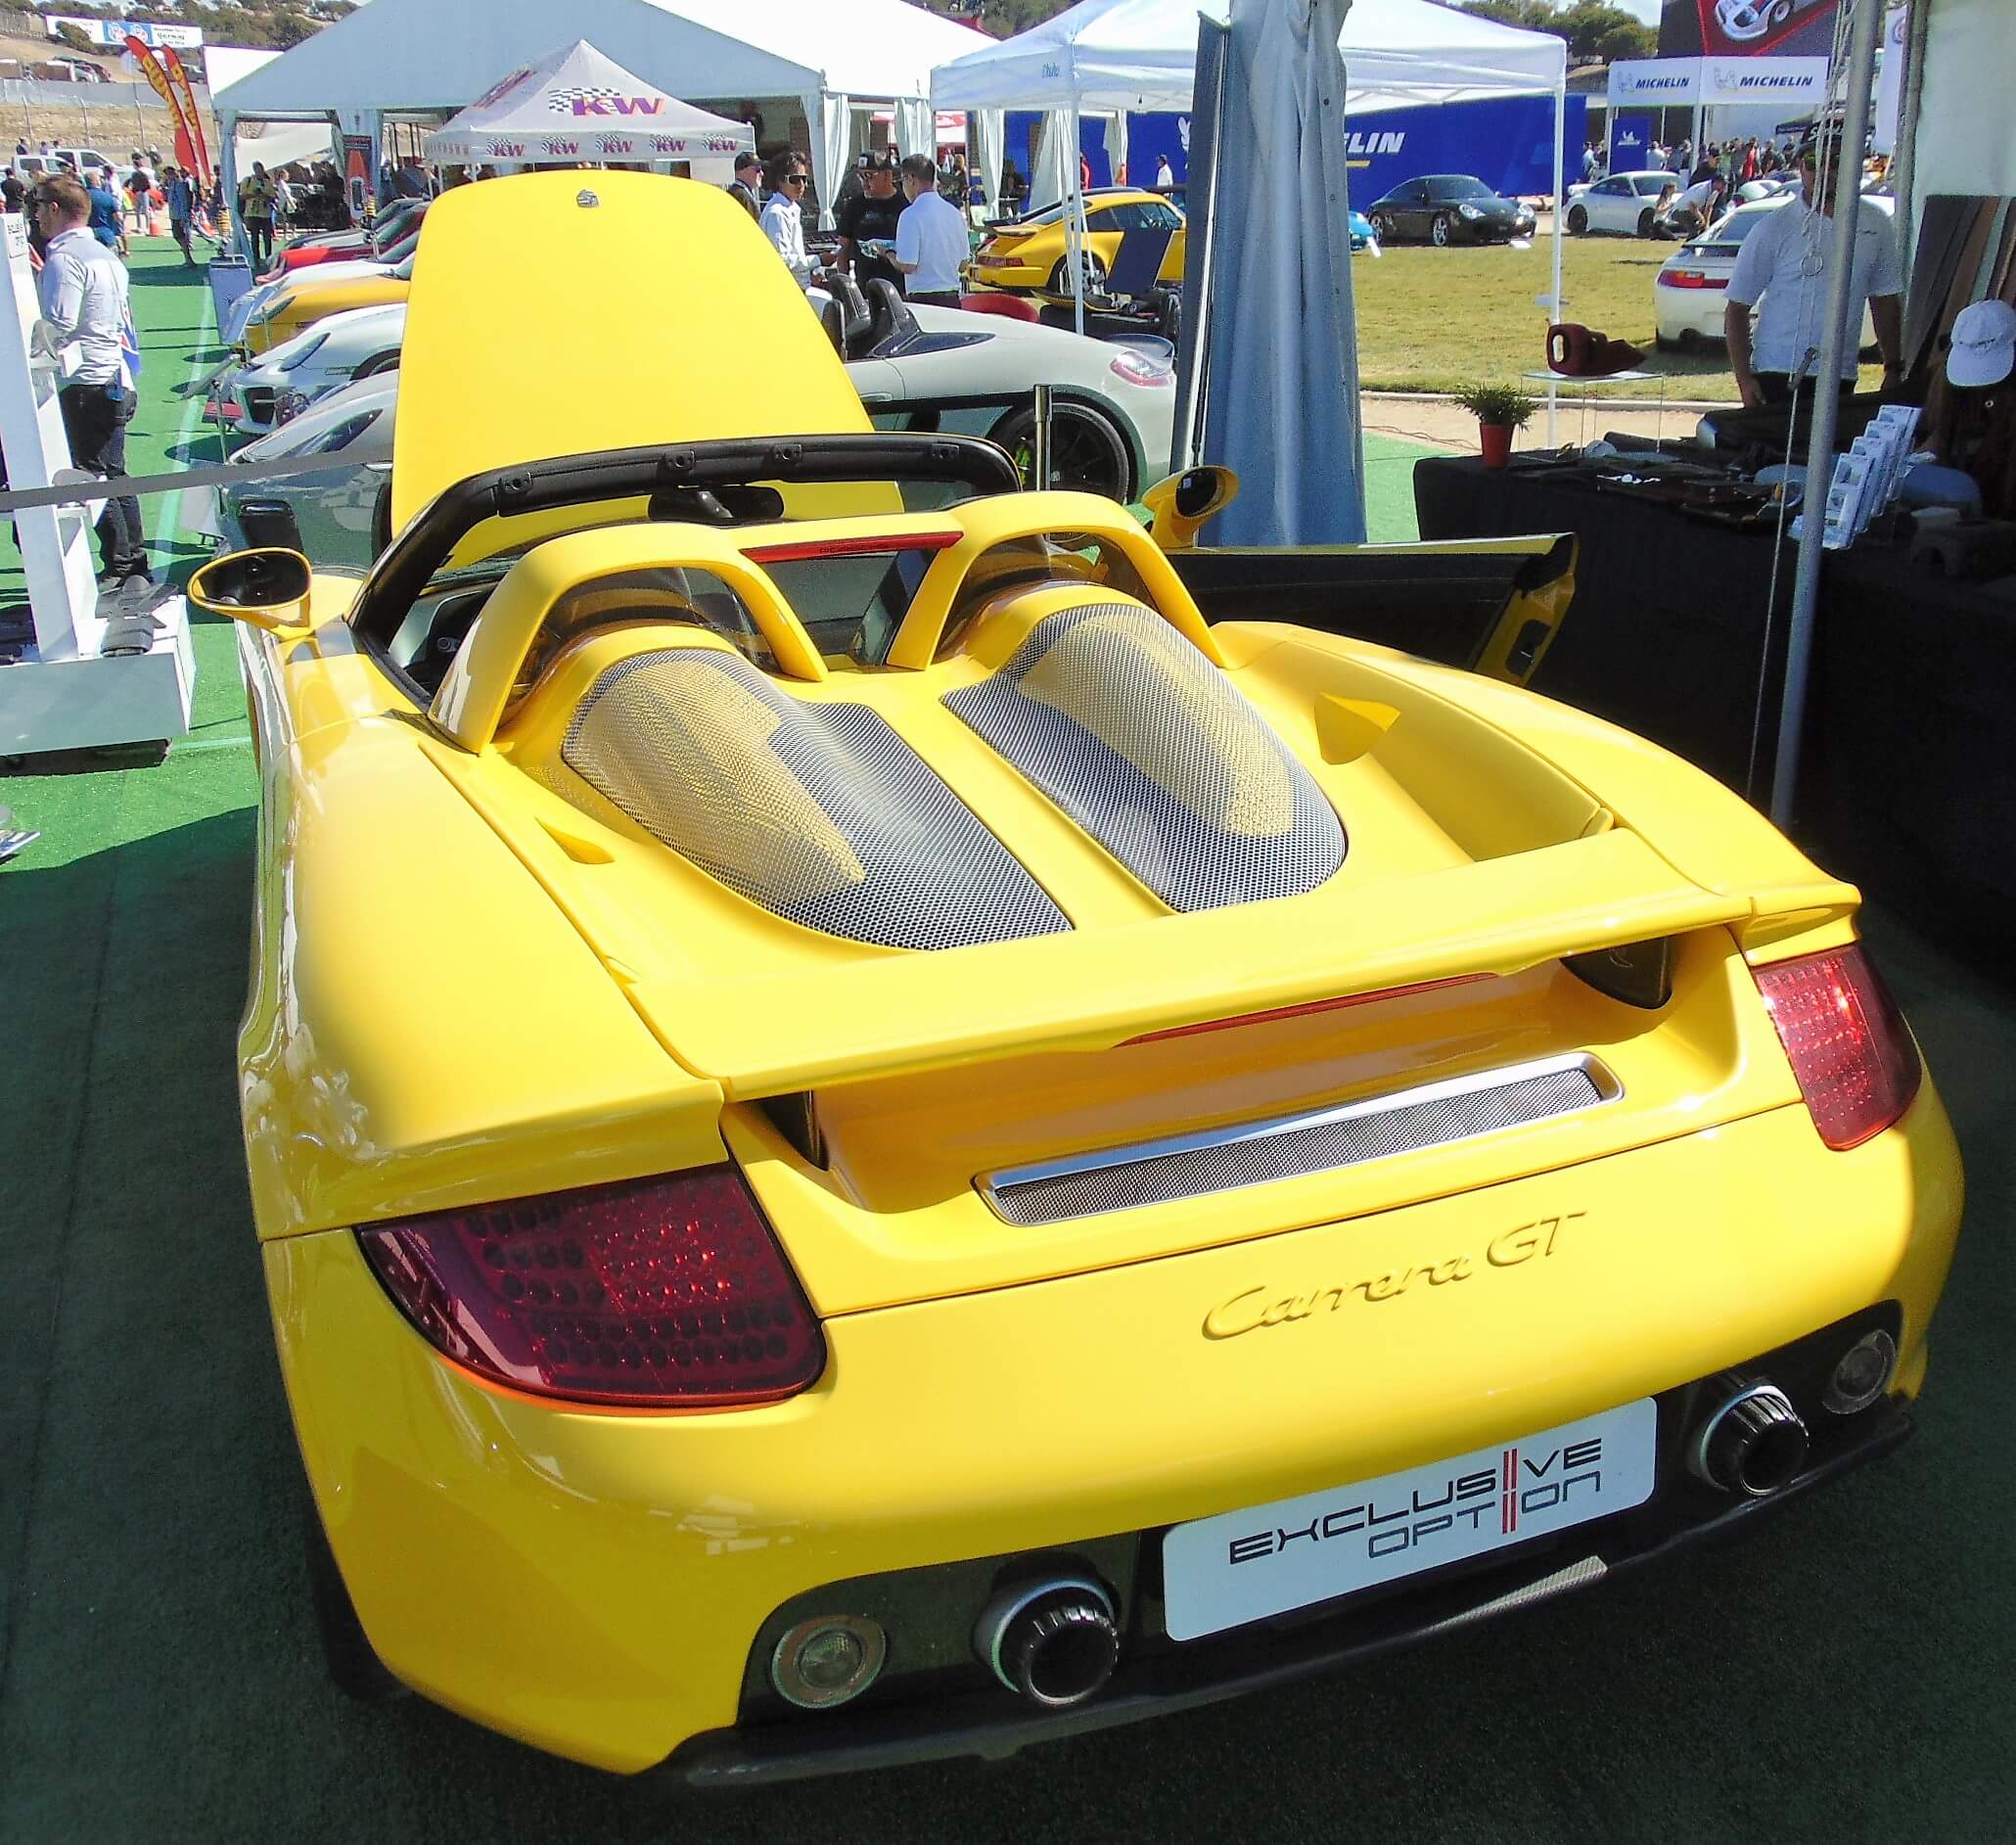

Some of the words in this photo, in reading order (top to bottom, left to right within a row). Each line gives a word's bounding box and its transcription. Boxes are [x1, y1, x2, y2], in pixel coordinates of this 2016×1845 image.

[1635, 76, 1690, 89] MICHELIN
[1739, 75, 1813, 87] MICHELIN
[573, 97, 664, 116] KW
[493, 144, 525, 157] KW
[549, 142, 578, 155] KW
[603, 140, 632, 153] KW
[657, 140, 685, 152] KW
[709, 140, 737, 152] KW
[1344, 132, 1405, 154] LIN
[1202, 1258, 1472, 1341] Carrera
[1486, 1211, 1587, 1268] GT
[1229, 1438, 1602, 1565] EXCLUSIVE
[1368, 1470, 1601, 1559] OPTION
